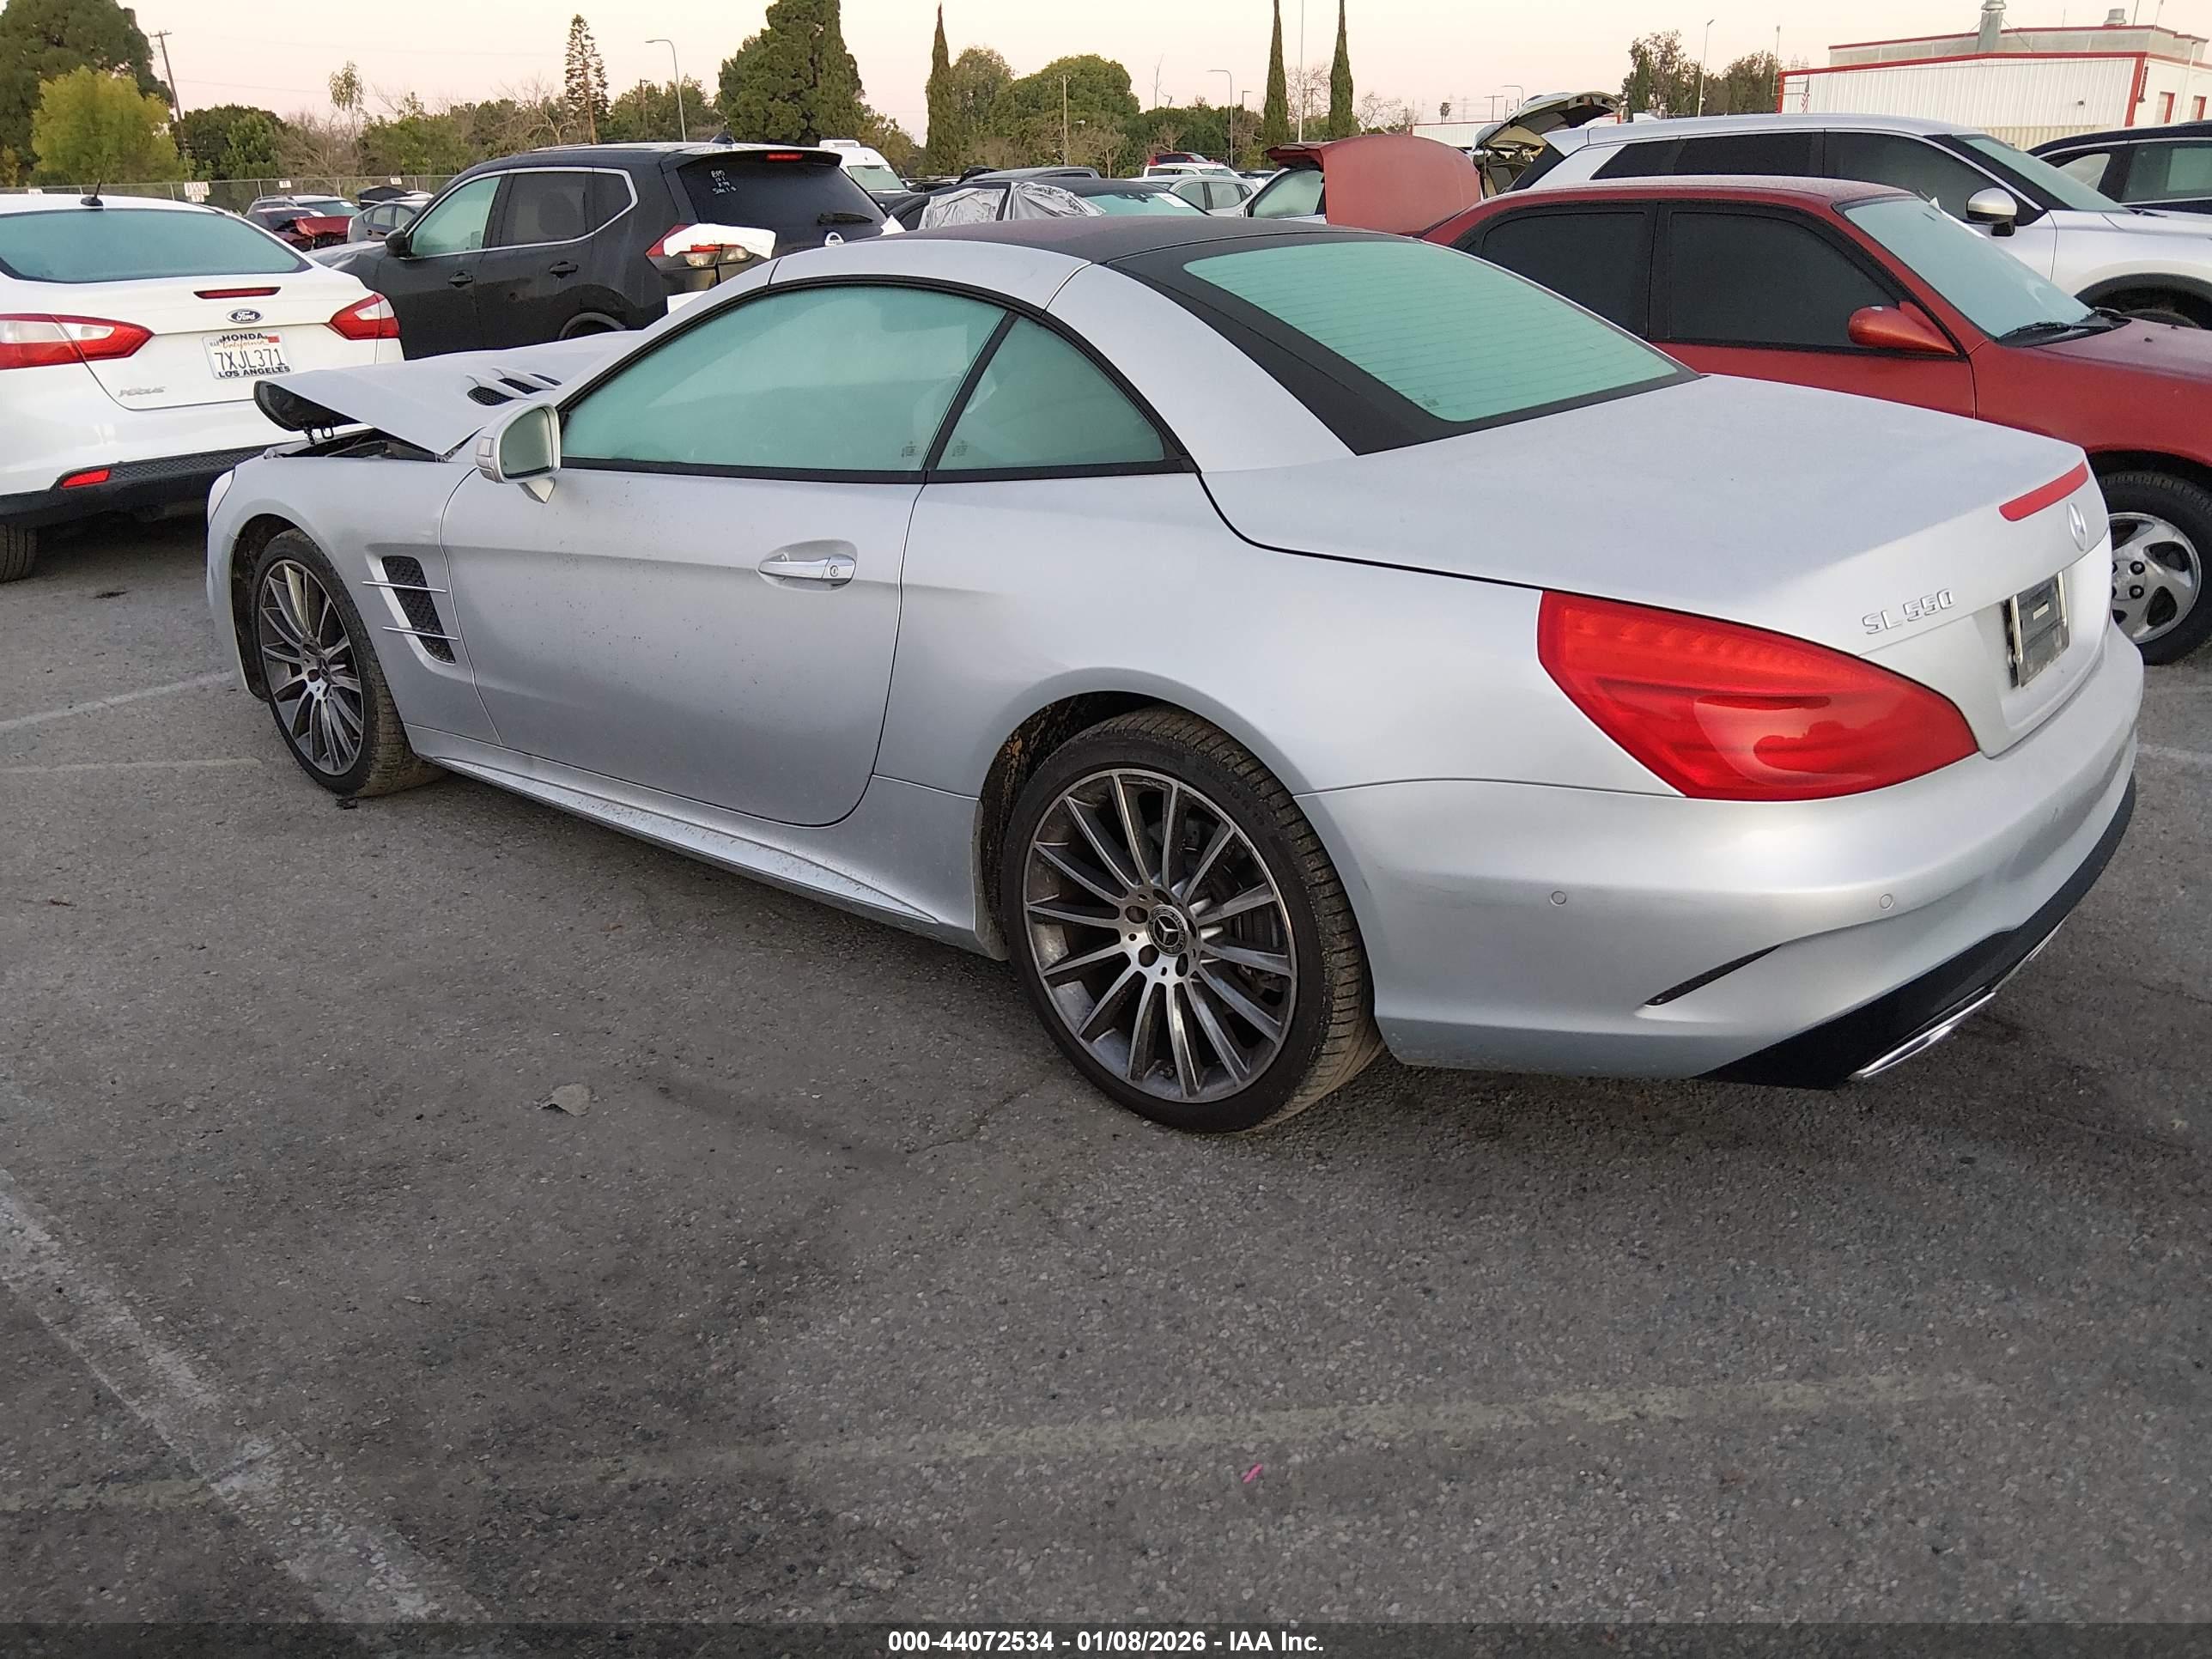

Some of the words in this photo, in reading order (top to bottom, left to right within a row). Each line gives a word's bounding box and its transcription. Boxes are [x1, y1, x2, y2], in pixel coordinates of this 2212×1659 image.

[236, 311, 256, 321] Ford
[222, 332, 263, 342] HONDA
[214, 348, 286, 371] 7XJL371
[243, 366, 290, 377] ANGELES
[1862, 609, 1903, 635] SL
[1903, 587, 1956, 623] 550
